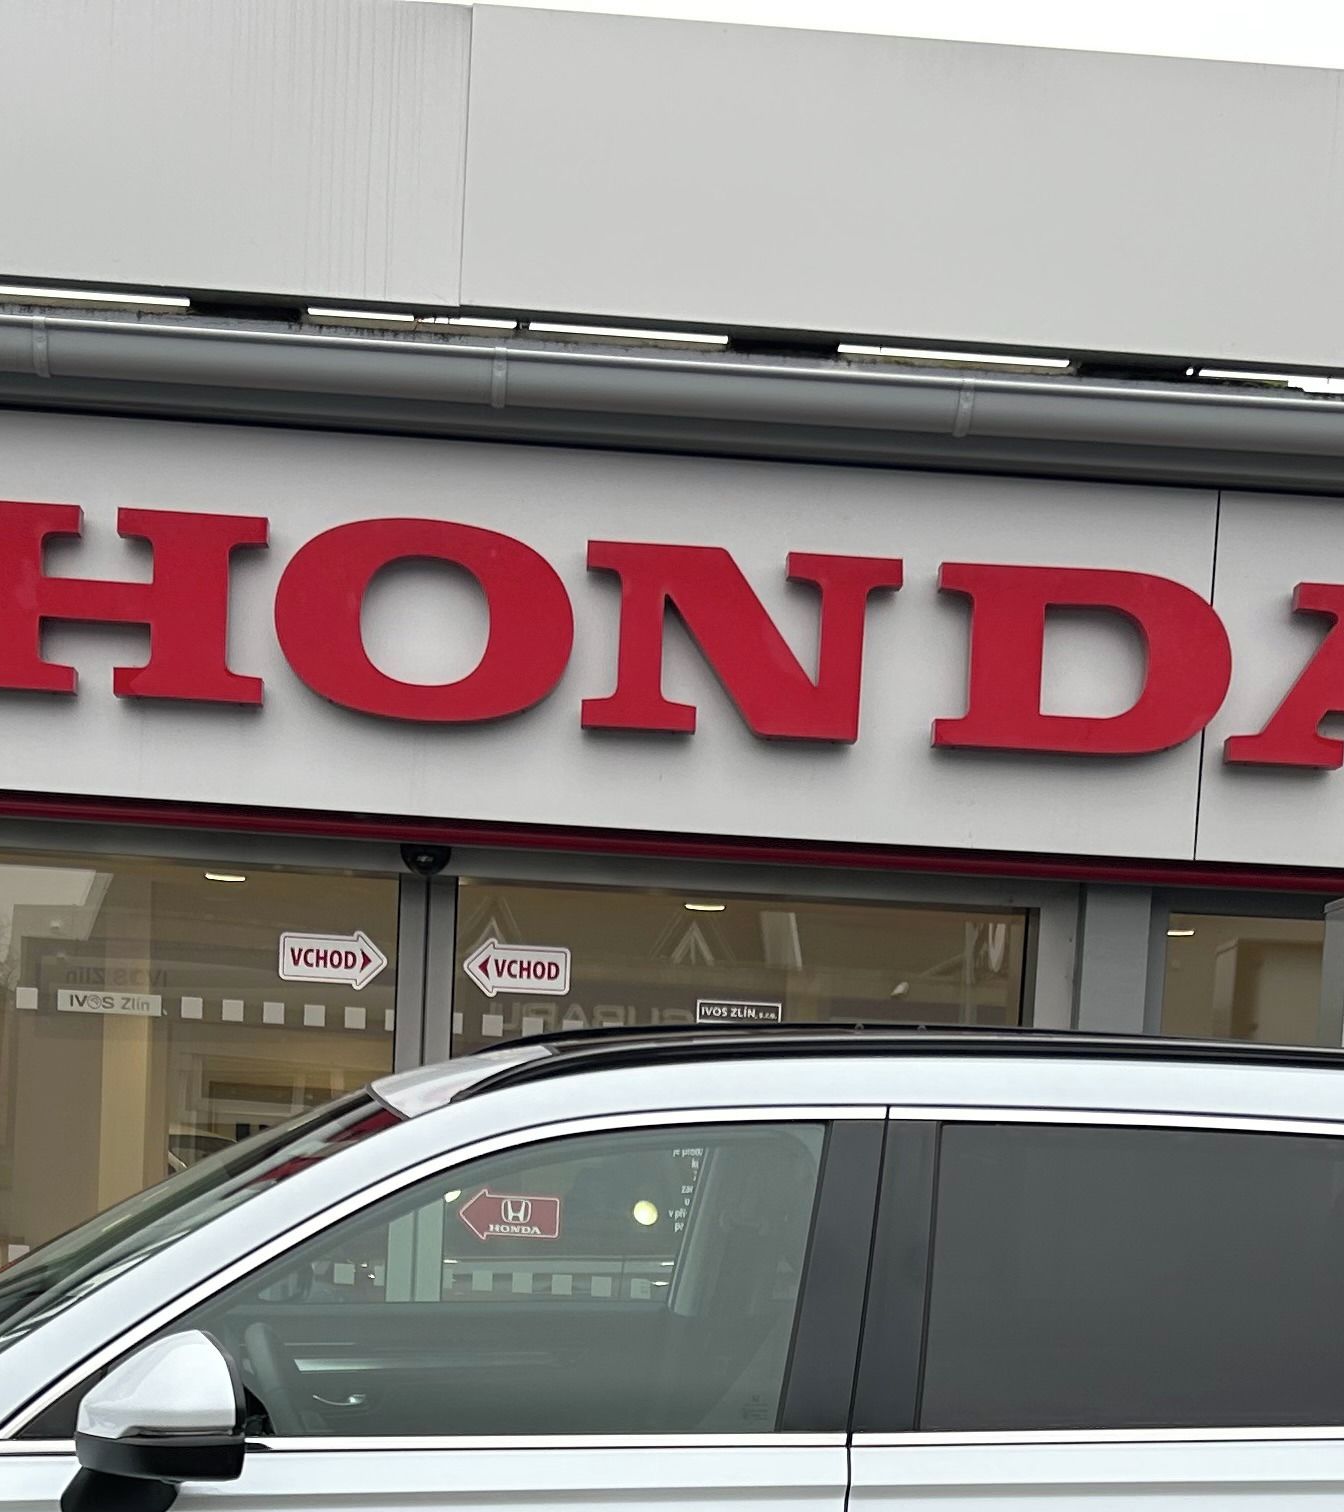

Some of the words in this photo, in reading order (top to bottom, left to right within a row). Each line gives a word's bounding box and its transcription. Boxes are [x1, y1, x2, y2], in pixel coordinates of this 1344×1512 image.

[290, 946, 357, 970] VCHOD
[494, 958, 560, 981] VCHOD
[121, 997, 150, 1012] Zlín
[701, 1006, 728, 1017] IVOS
[488, 1223, 541, 1235] HONDA
